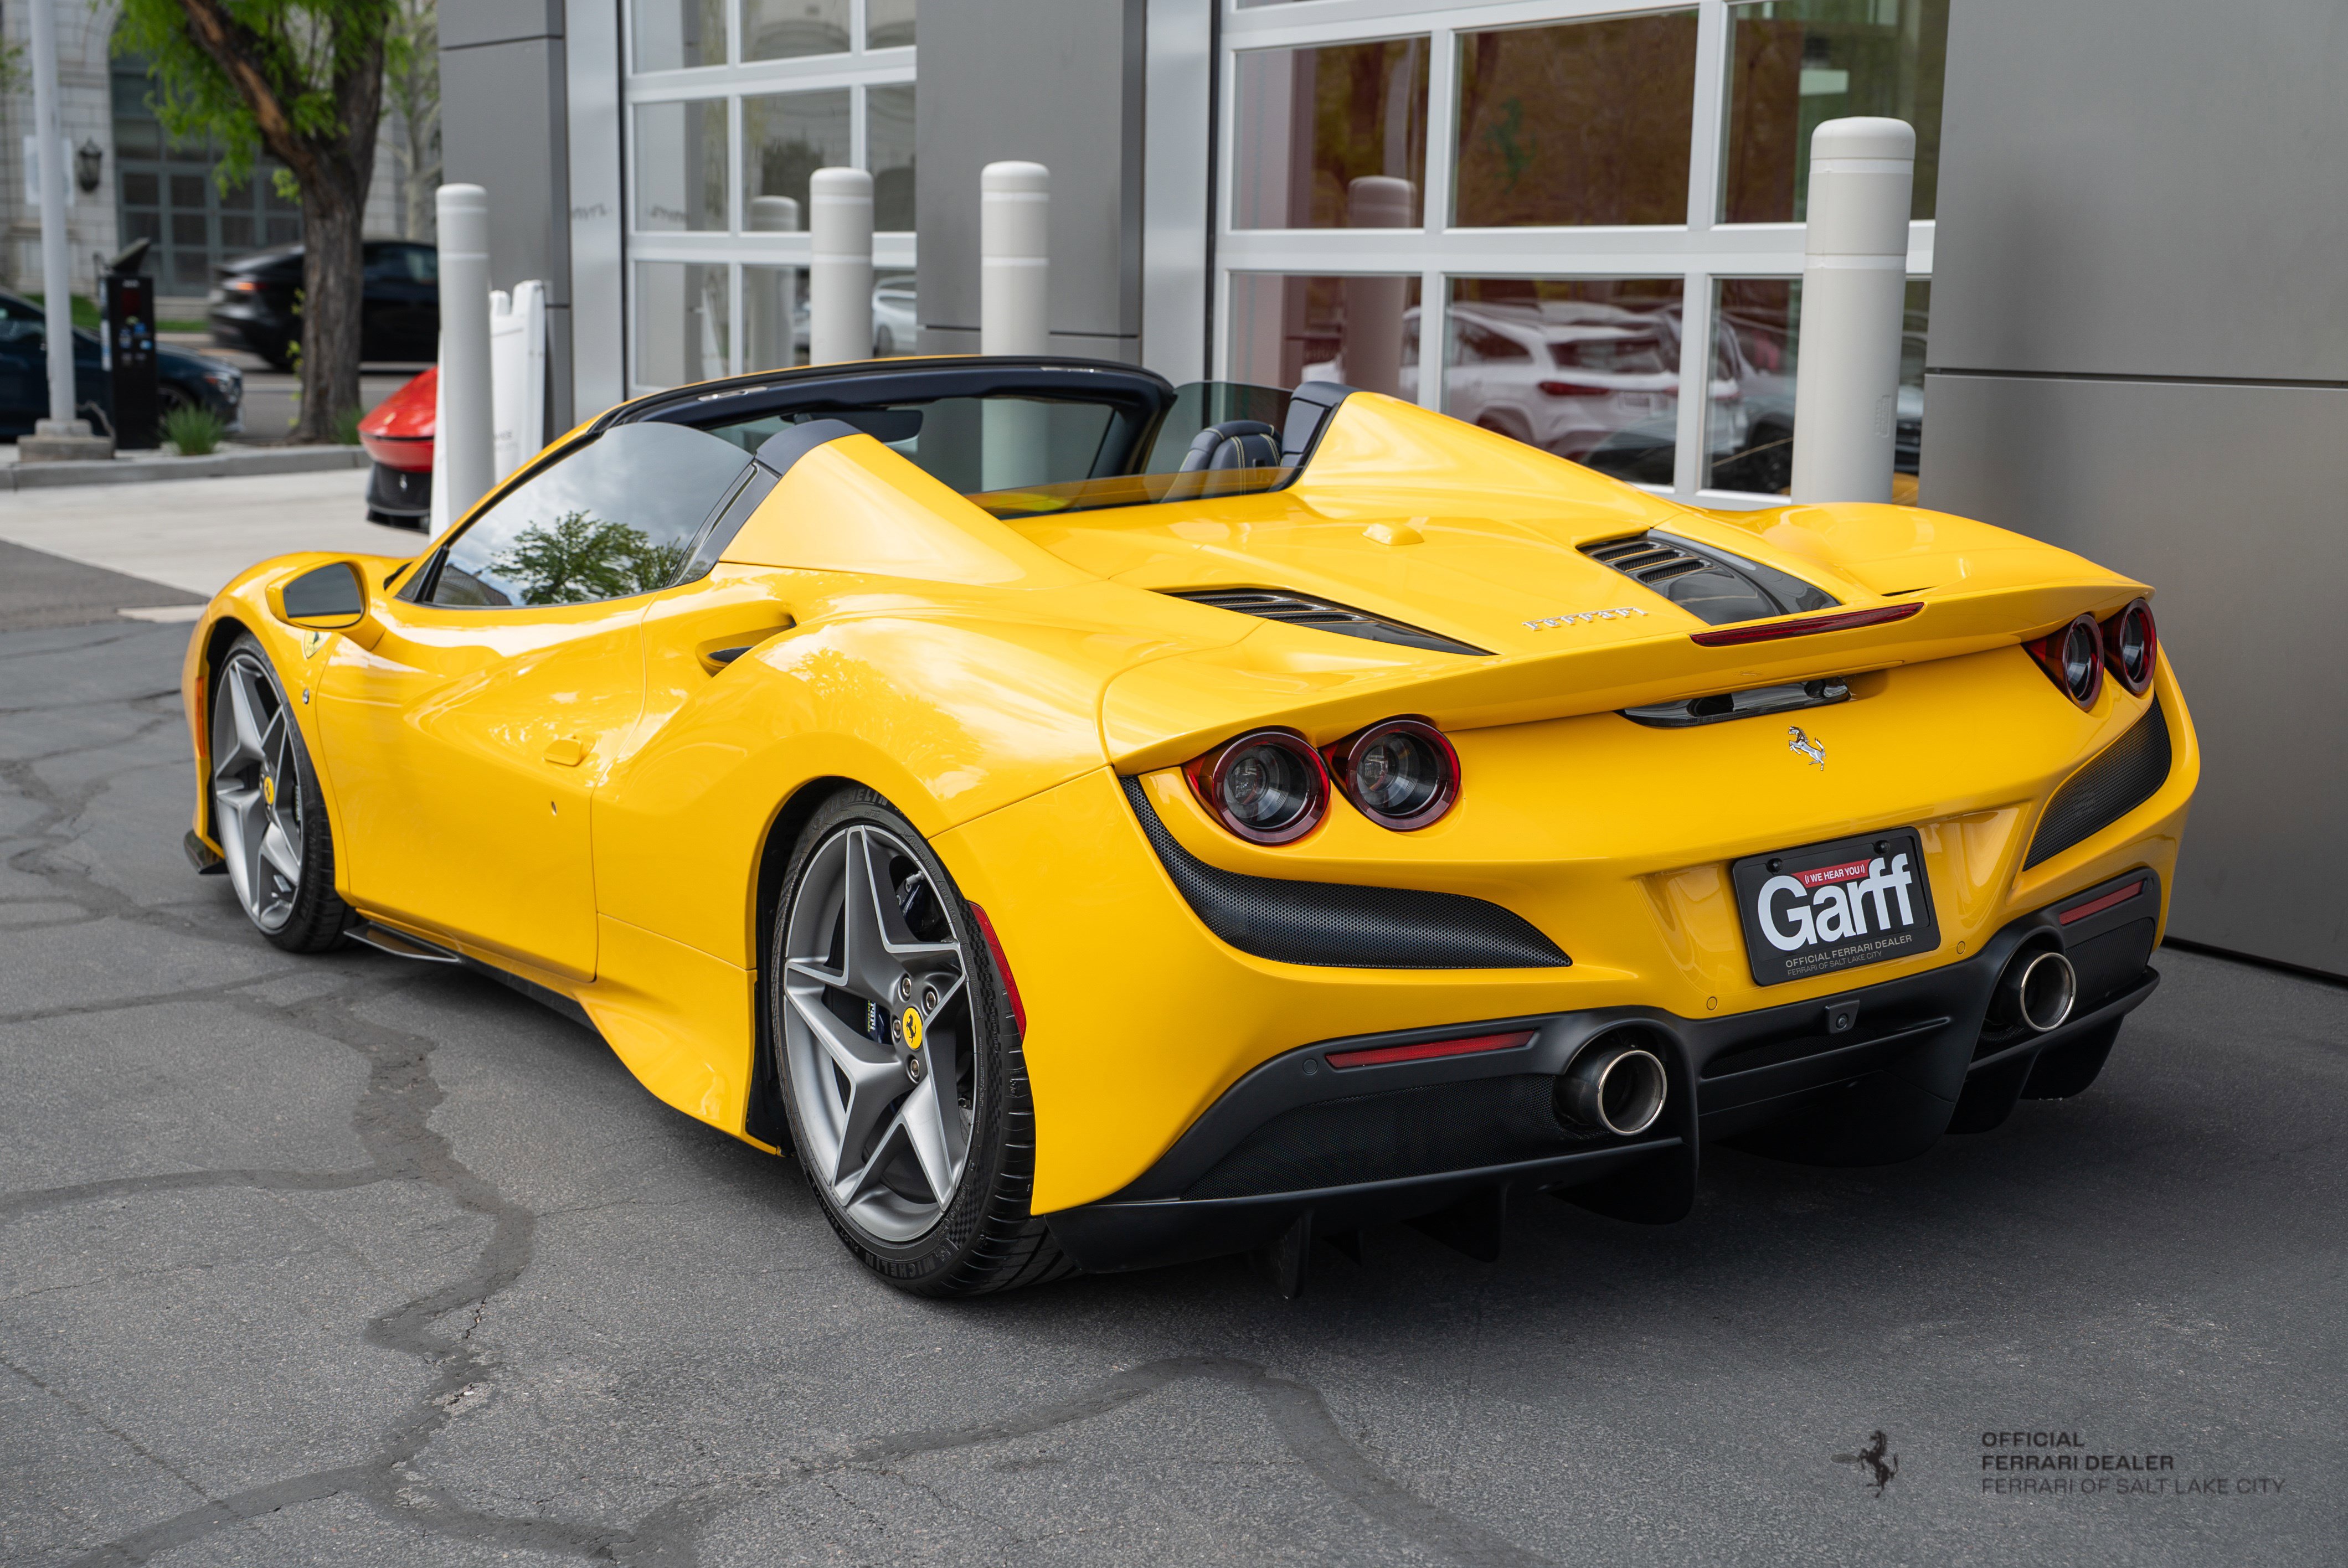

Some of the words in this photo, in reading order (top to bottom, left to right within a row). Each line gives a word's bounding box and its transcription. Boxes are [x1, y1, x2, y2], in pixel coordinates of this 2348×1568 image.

[1522, 607, 1648, 631] Ferrari
[1810, 872, 1824, 883] WE
[1824, 870, 1845, 880] HEAR
[1845, 865, 1861, 876] YOU
[1758, 853, 1914, 951] Garff
[1785, 952, 1831, 968] OFFICIAL
[1831, 942, 1873, 958] FERRARI
[1875, 934, 1913, 948] DEALER
[1787, 964, 1818, 977] FERRARI
[1830, 957, 1847, 968] SALT
[1847, 953, 1865, 963] LAKE
[1866, 950, 1882, 960] CITY
[818, 1196, 838, 1229] SPORT
[840, 1230, 859, 1253] PILOT
[865, 1251, 936, 1278] MICHELIN
